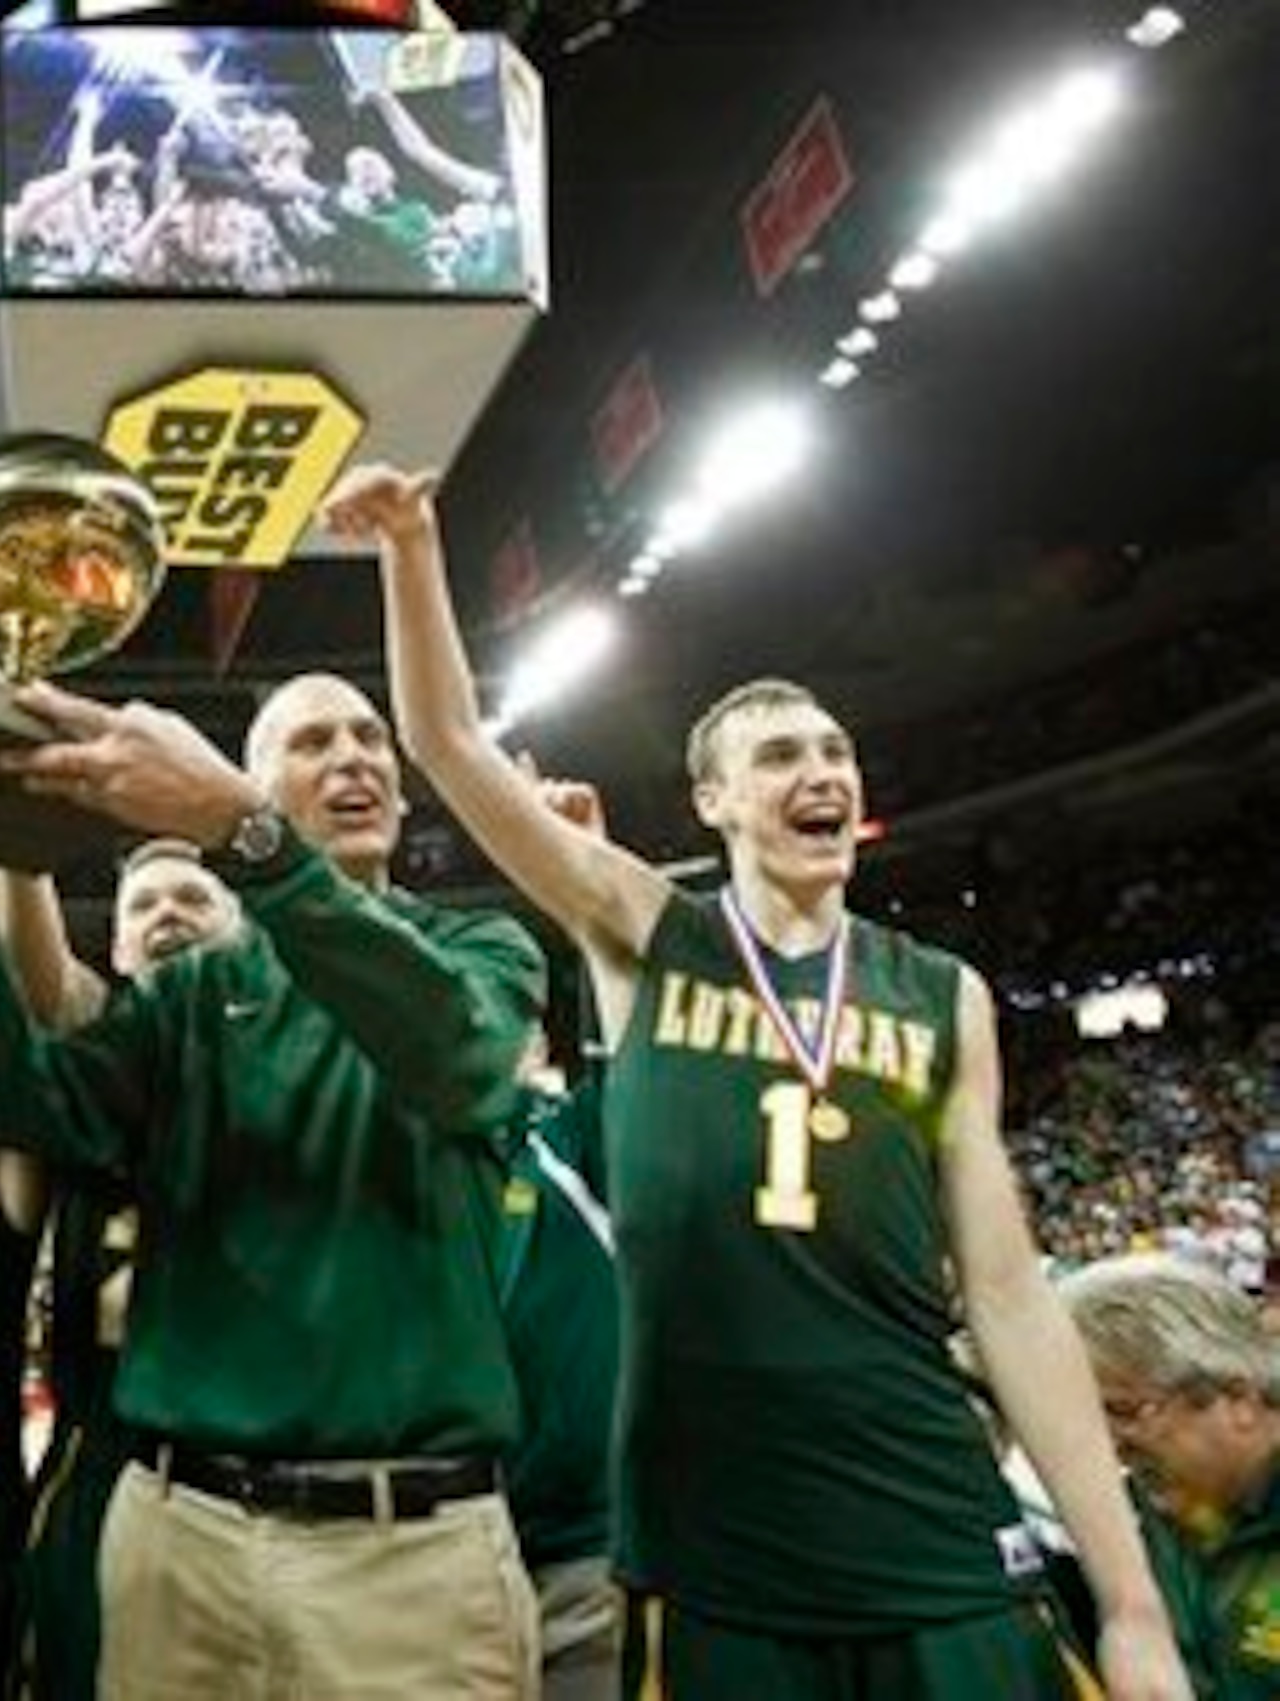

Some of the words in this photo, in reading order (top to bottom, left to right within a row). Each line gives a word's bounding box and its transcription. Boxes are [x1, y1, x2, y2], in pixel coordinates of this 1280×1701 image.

[136, 410, 233, 546] BU
[183, 404, 320, 558] BEST
[755, 1081, 817, 1232] 1
